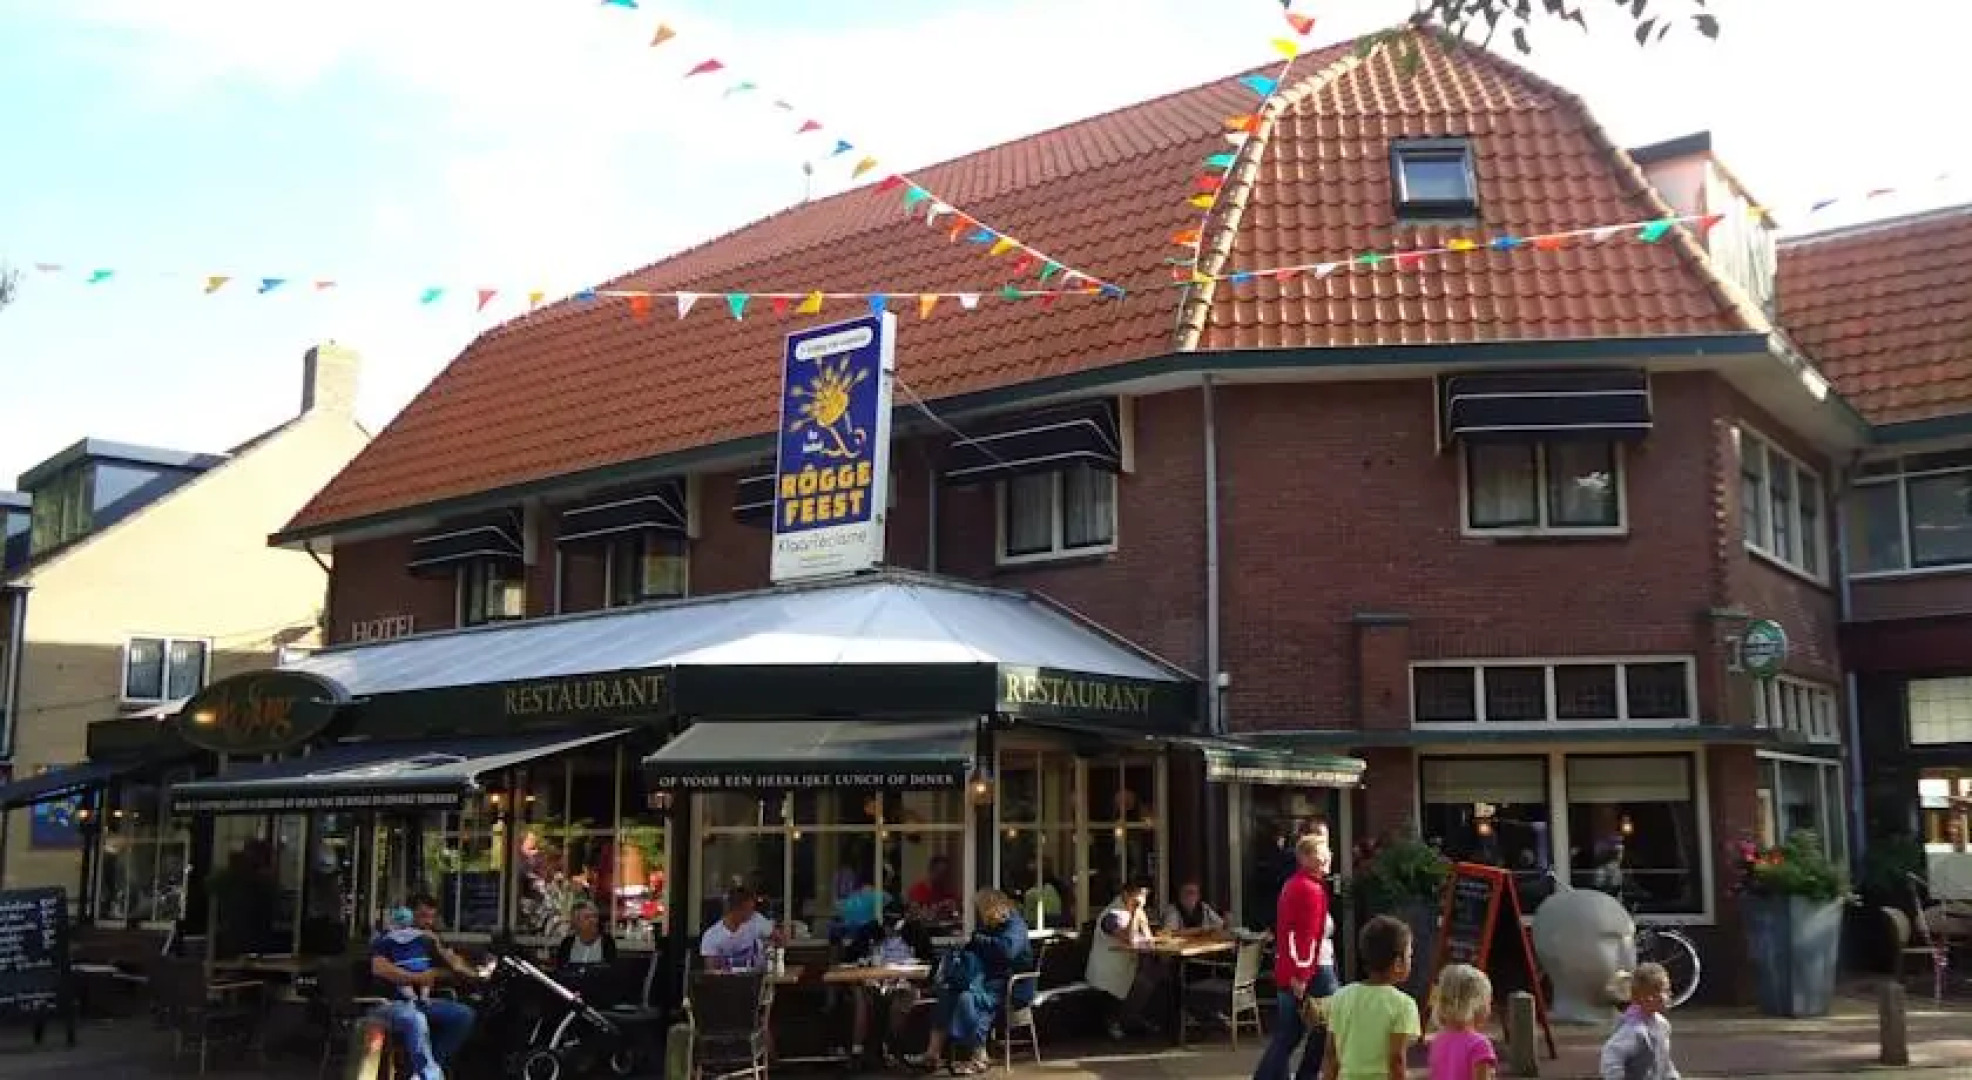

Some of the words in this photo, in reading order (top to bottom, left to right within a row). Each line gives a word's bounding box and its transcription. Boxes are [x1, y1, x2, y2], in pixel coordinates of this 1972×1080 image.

[784, 489, 865, 527] FEEST
[504, 675, 666, 714] RESTAURANT
[1004, 673, 1151, 711] RESTAURANT
[659, 776, 677, 787] OF
[681, 775, 720, 787] VOOR
[725, 775, 752, 787] EEN
[757, 774, 830, 788] HEERLIJKE
[835, 774, 884, 785] LUNCH
[887, 774, 906, 785] OF
[910, 773, 954, 785] DINER
